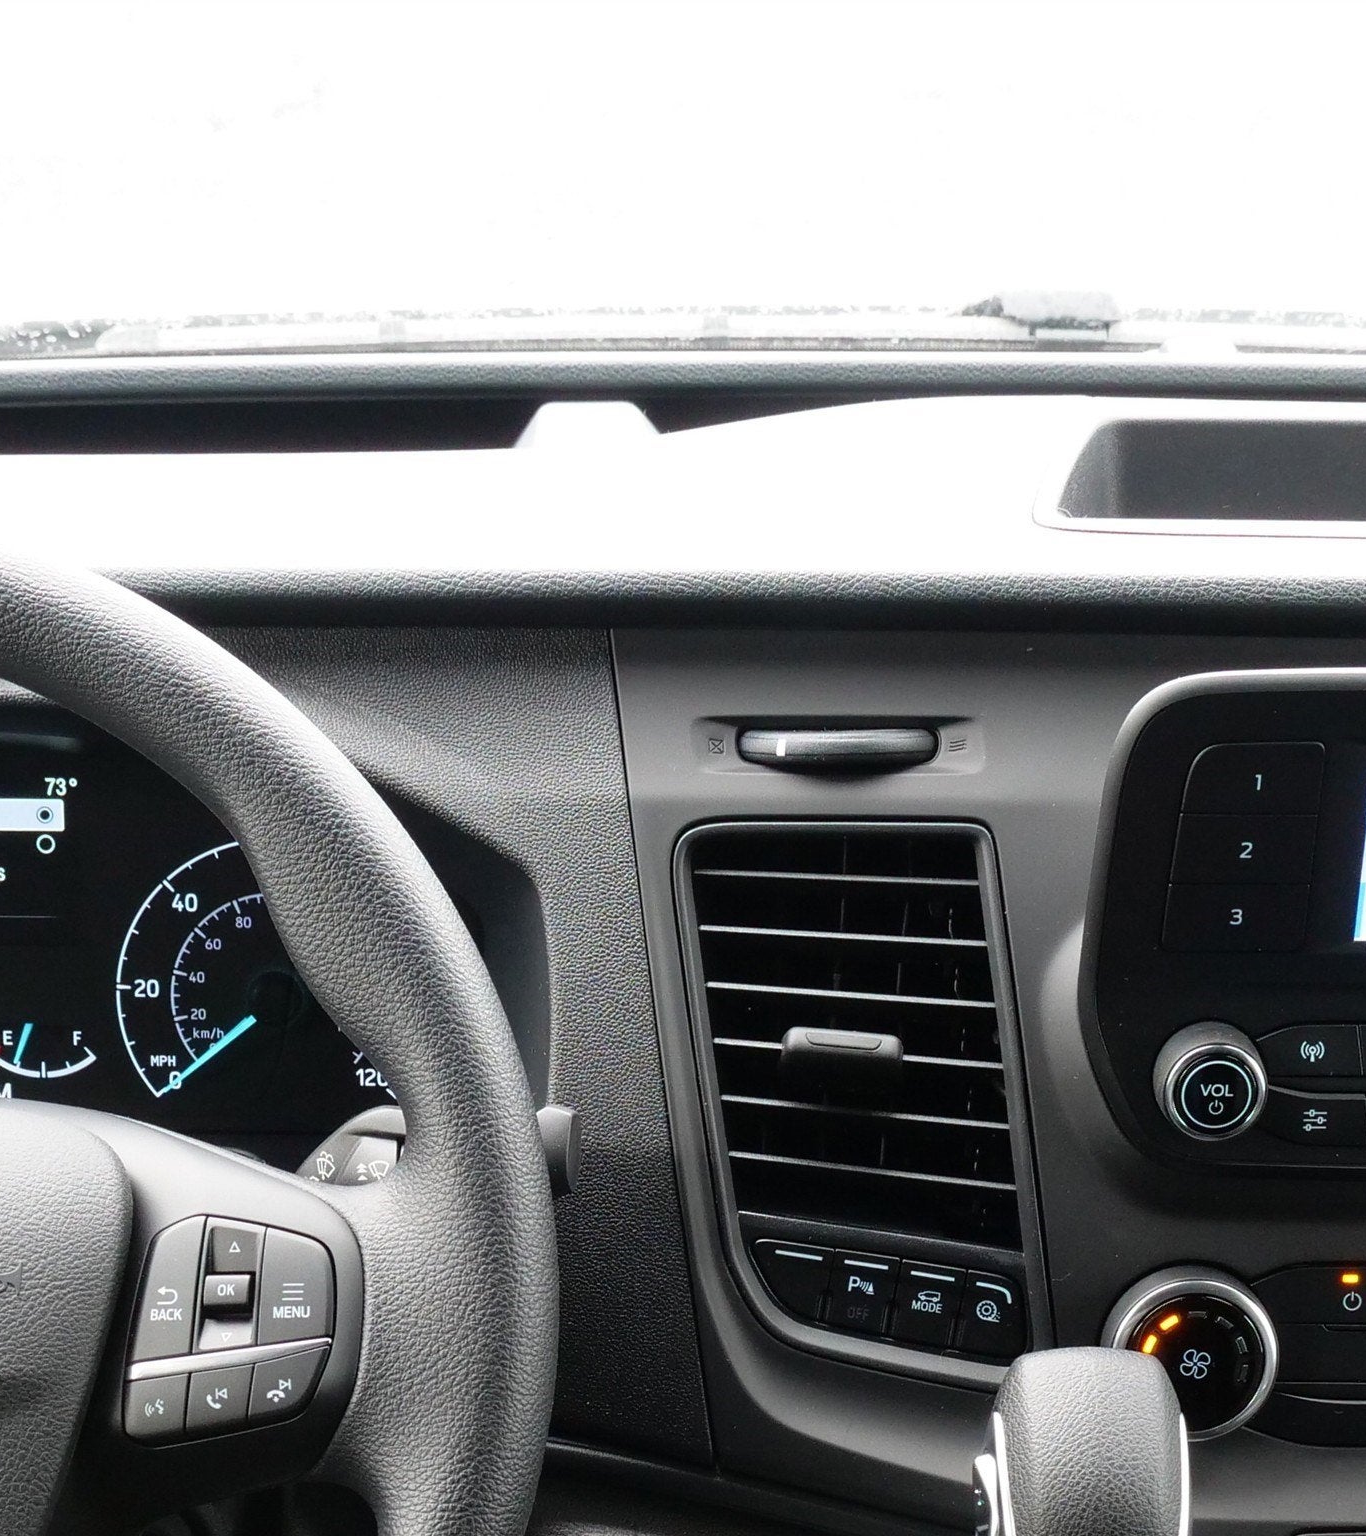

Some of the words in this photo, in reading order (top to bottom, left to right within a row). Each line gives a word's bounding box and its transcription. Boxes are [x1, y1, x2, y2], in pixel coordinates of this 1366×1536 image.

[45, 778, 77, 796] 73°
[1256, 775, 1261, 790] 1
[1240, 842, 1252, 858] 2
[172, 893, 198, 913] 40
[236, 917, 251, 928] 80
[1230, 909, 1242, 925] 3
[205, 938, 222, 950] 60
[189, 972, 204, 983] 40
[135, 979, 159, 997] 20
[191, 1009, 206, 1020] 20
[3, 1031, 13, 1045] E
[73, 1031, 81, 1045] F
[193, 1028, 225, 1039] km/h
[151, 1056, 175, 1066] MPH
[1201, 1084, 1233, 1096] VOL
[218, 1283, 235, 1295] OK
[273, 1306, 310, 1318] MENU
[912, 1300, 943, 1314] MODE
[151, 1308, 182, 1320] BACK
